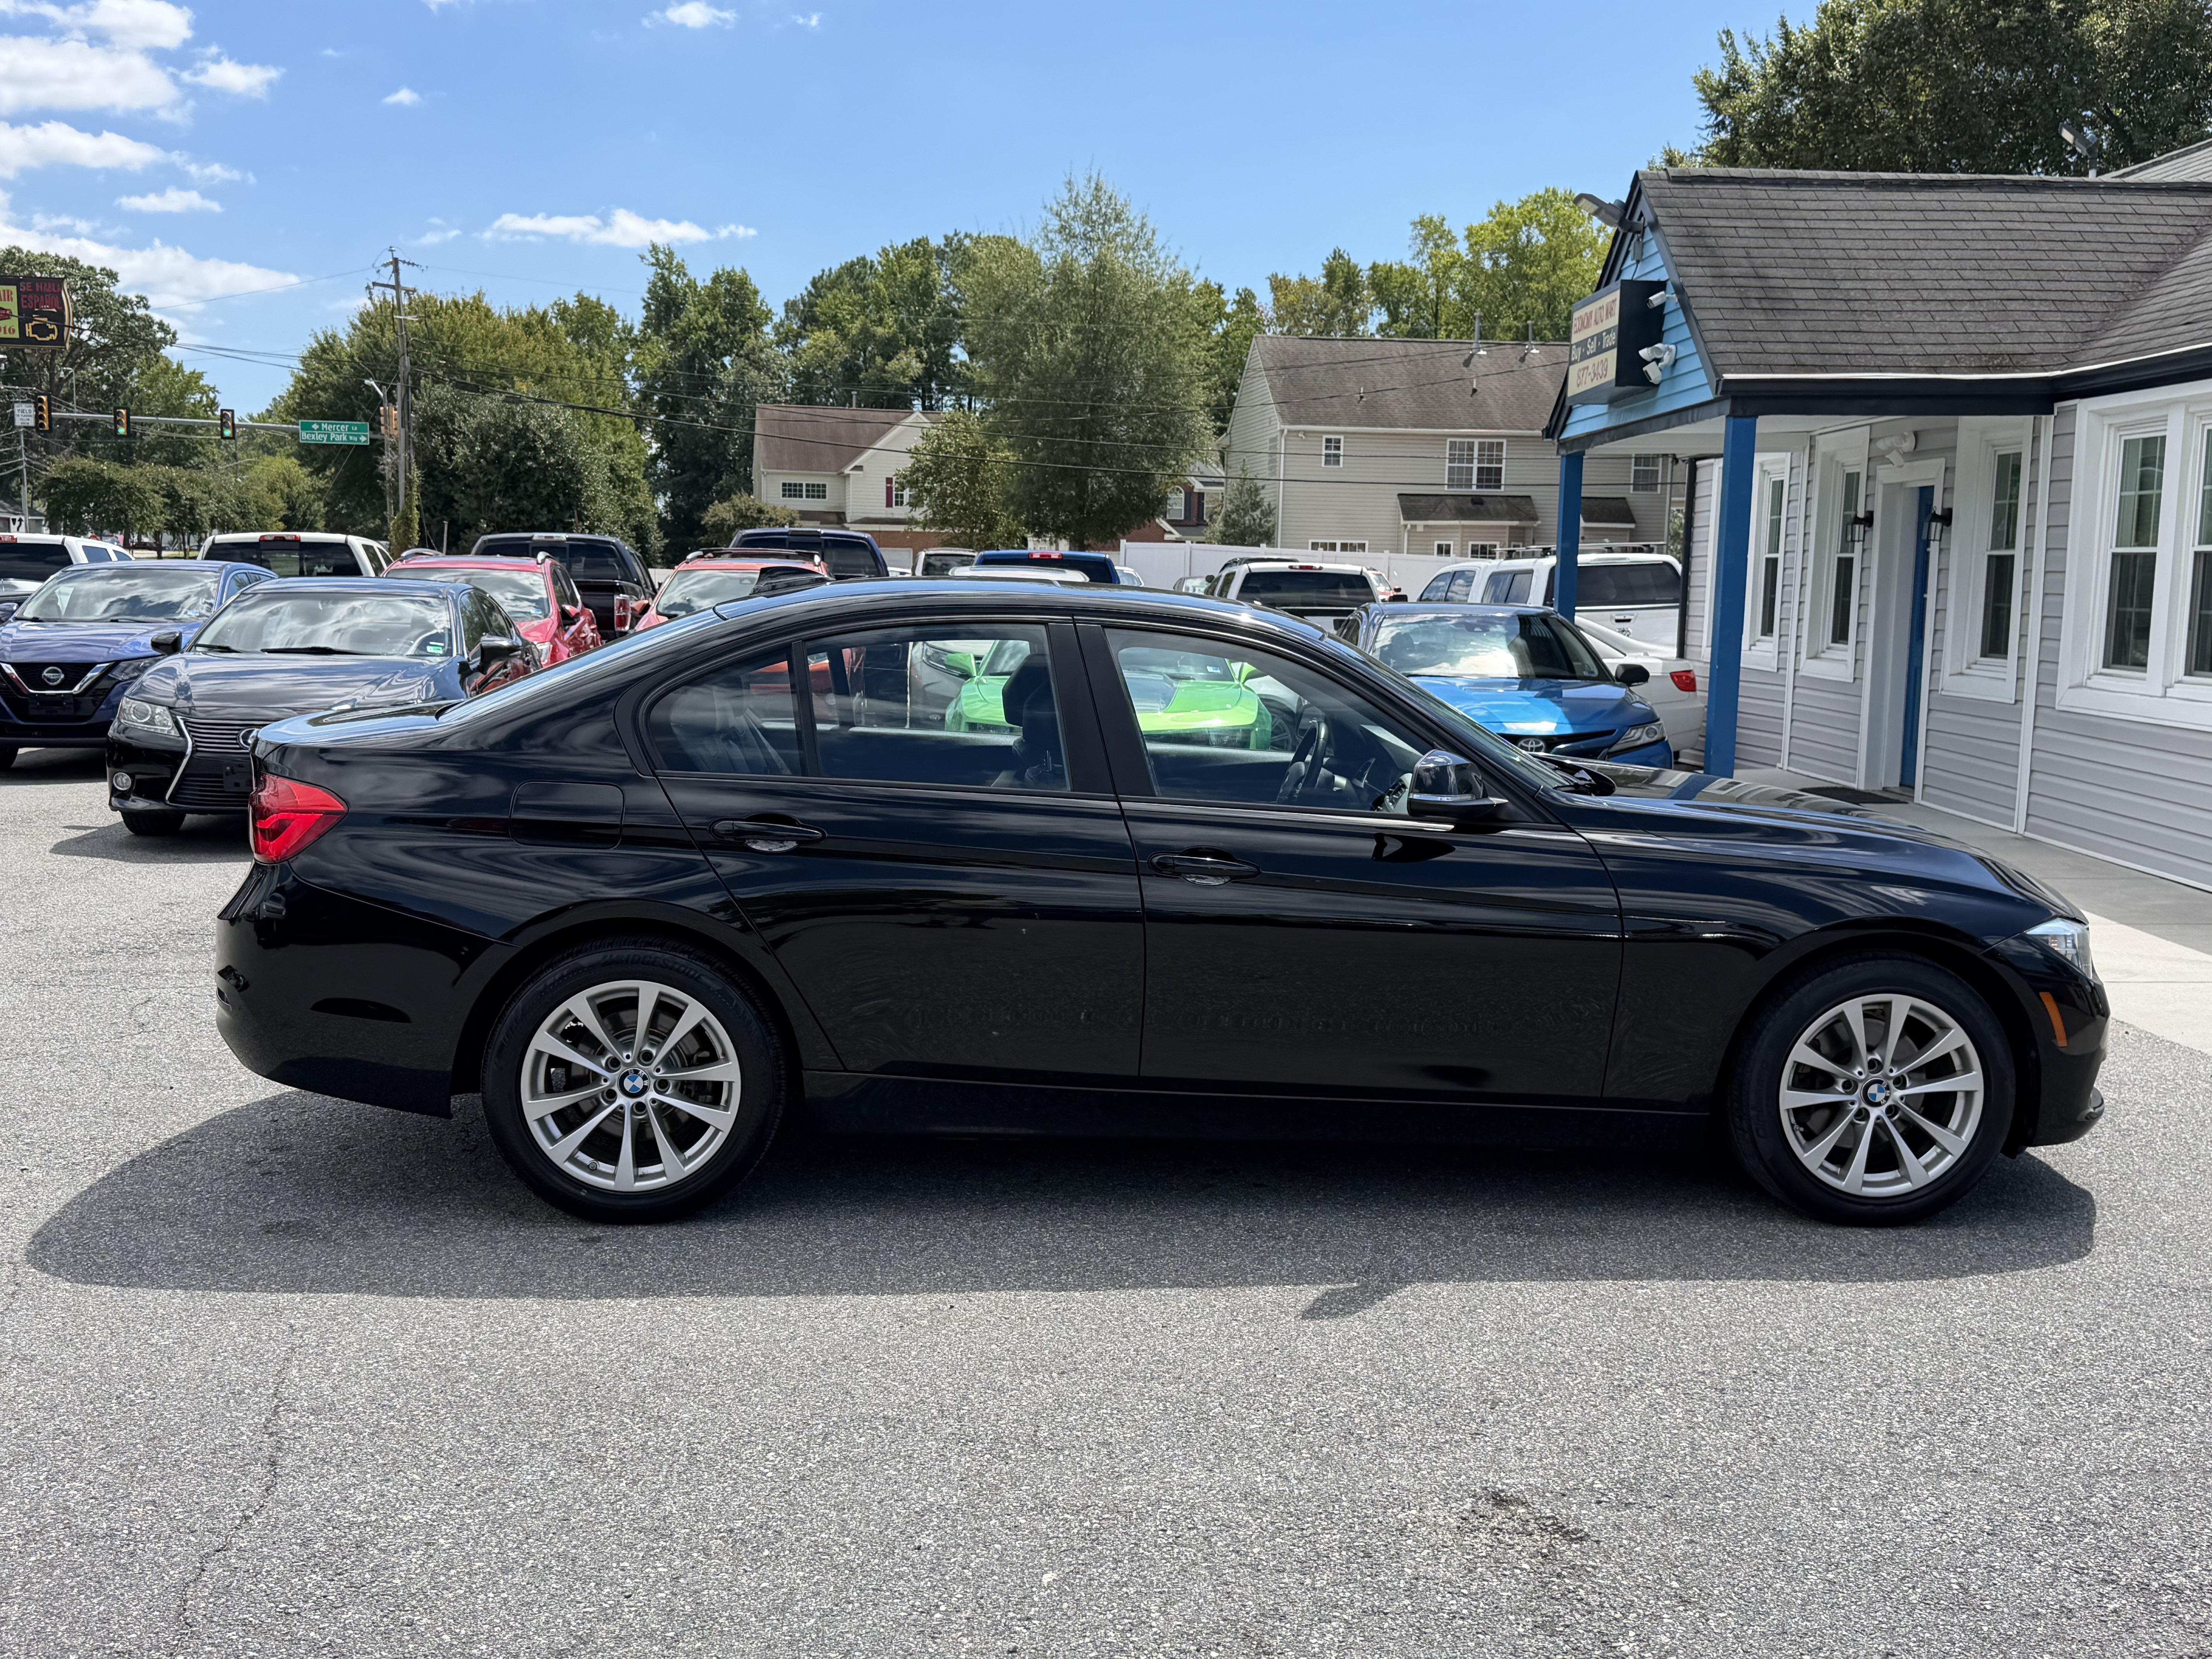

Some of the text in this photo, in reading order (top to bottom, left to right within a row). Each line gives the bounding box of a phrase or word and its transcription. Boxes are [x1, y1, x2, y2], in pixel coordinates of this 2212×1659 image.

[20, 282, 33, 292] SE
[0, 326, 15, 335] 16
[1571, 329, 1616, 362] Buy Sell Trade
[1577, 358, 1607, 388] 877-3439
[321, 423, 349, 431] Mercer
[302, 432, 327, 442] Bexley
[628, 1069, 649, 1085] BMW
[1881, 1081, 1890, 1105] BMW
